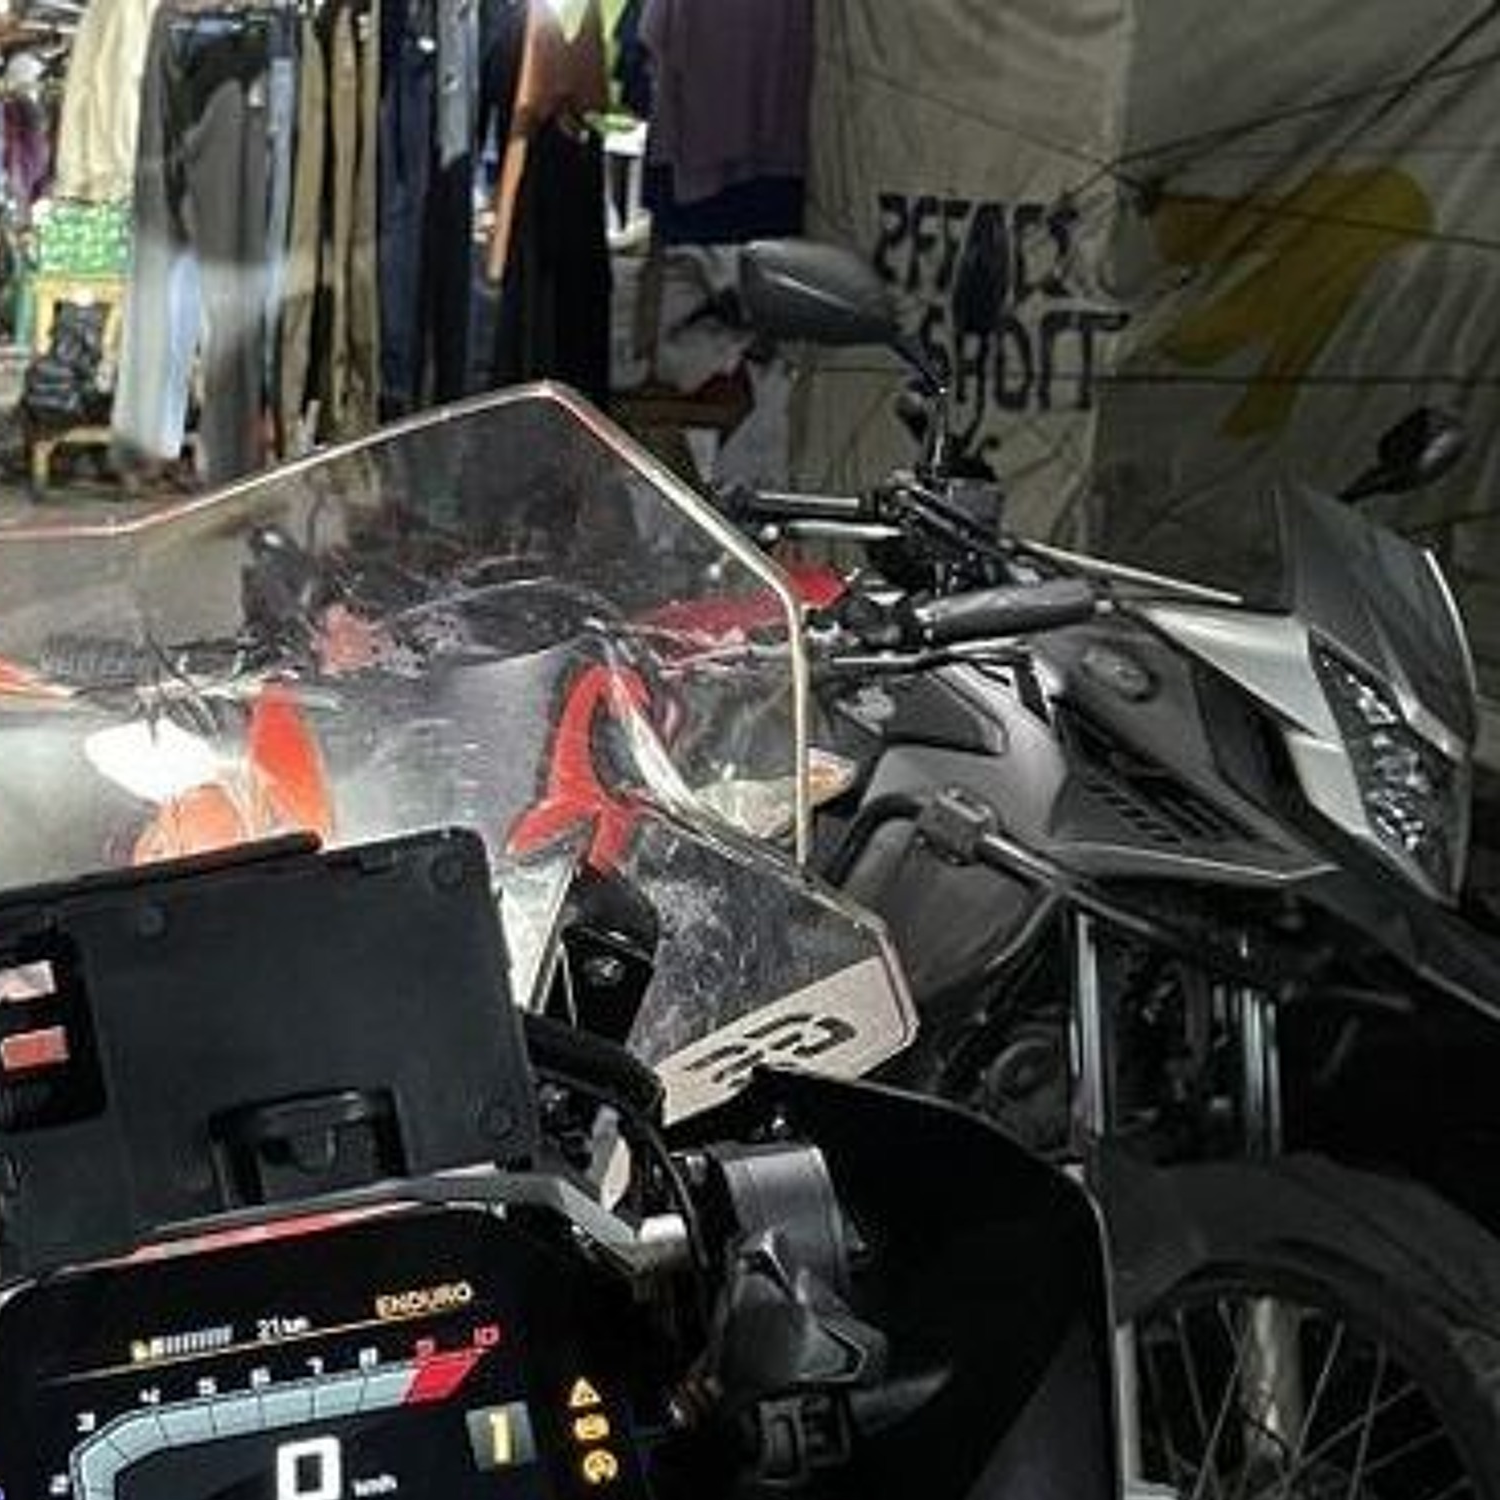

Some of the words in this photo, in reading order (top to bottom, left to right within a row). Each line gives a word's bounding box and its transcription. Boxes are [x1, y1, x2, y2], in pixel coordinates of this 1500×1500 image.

[376, 1282, 473, 1318] ENDURO
[305, 1355, 324, 1374] 7
[76, 1412, 96, 1432] 3
[490, 1411, 511, 1463] 1
